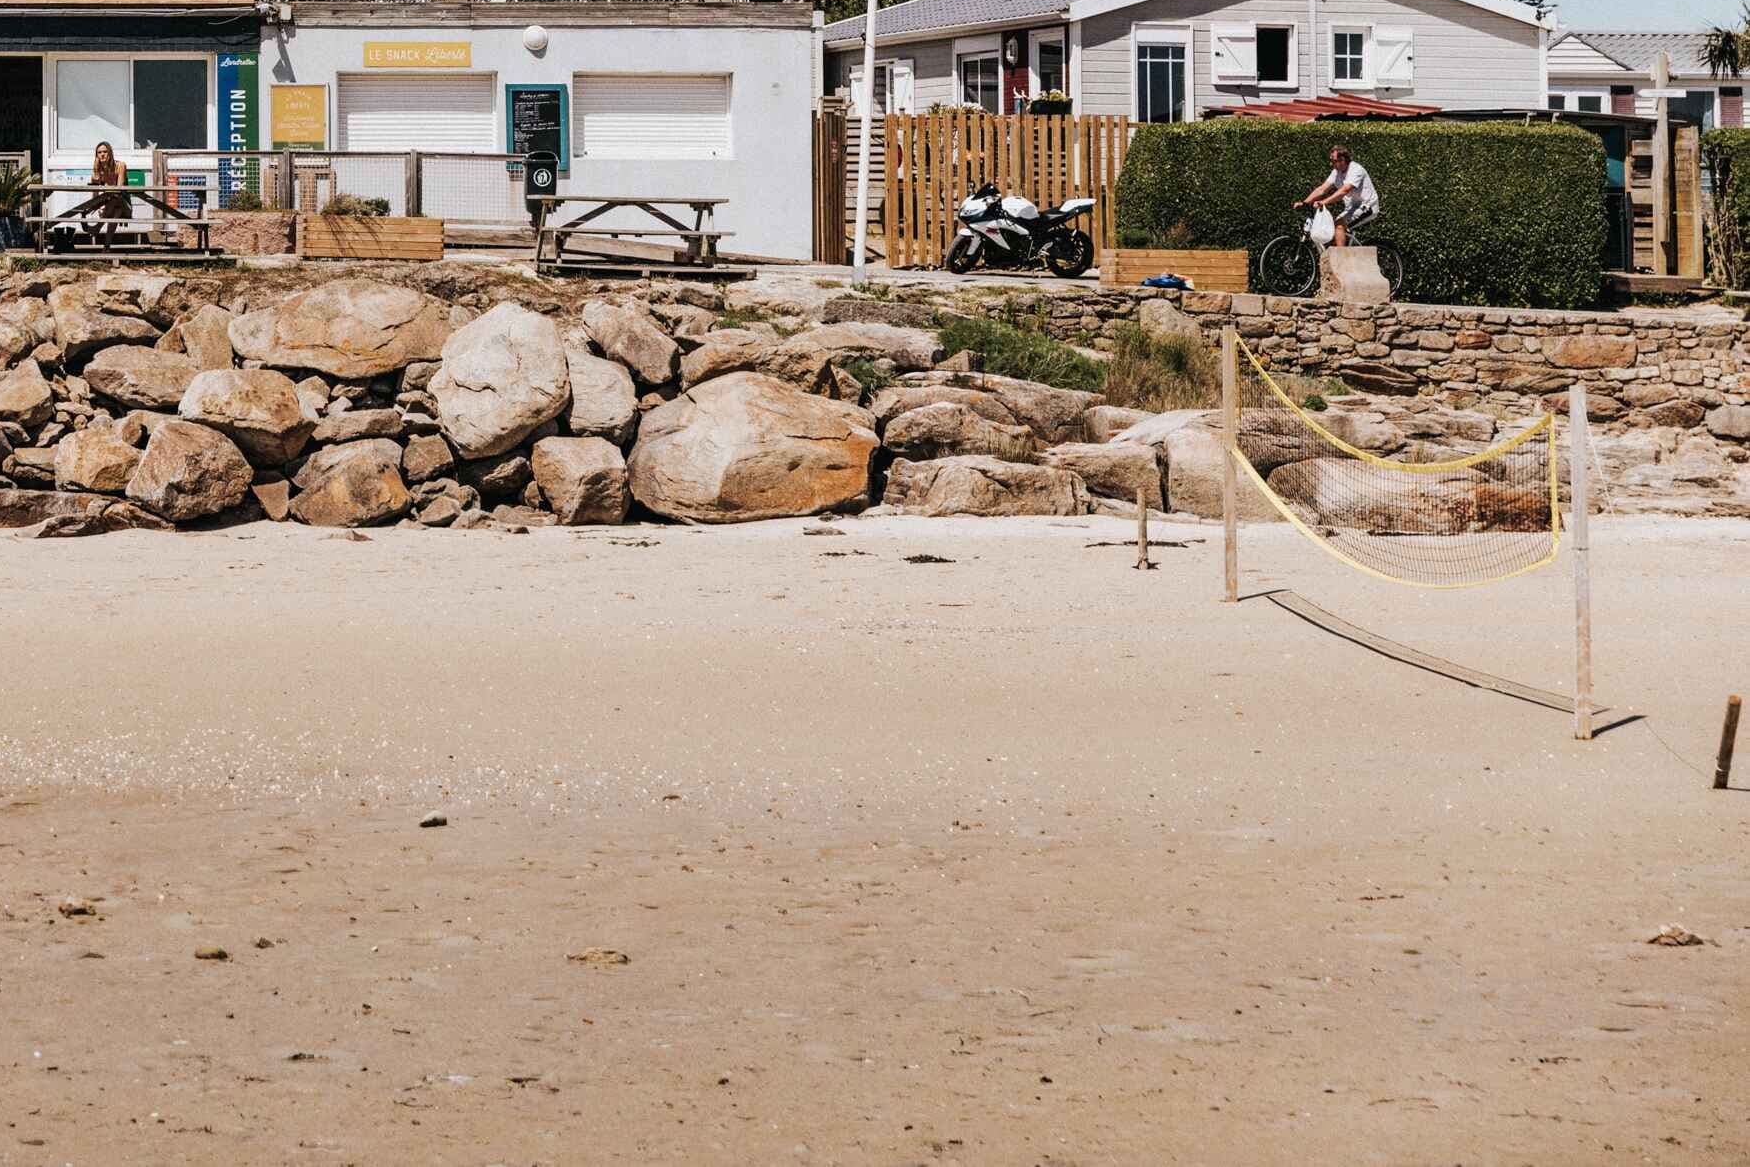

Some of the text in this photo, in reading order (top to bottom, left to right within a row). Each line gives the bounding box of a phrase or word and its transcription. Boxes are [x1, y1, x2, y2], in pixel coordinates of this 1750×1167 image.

[369, 49, 382, 61] LE
[386, 49, 421, 61] SNACK
[227, 89, 247, 191] RÉCEPTION
